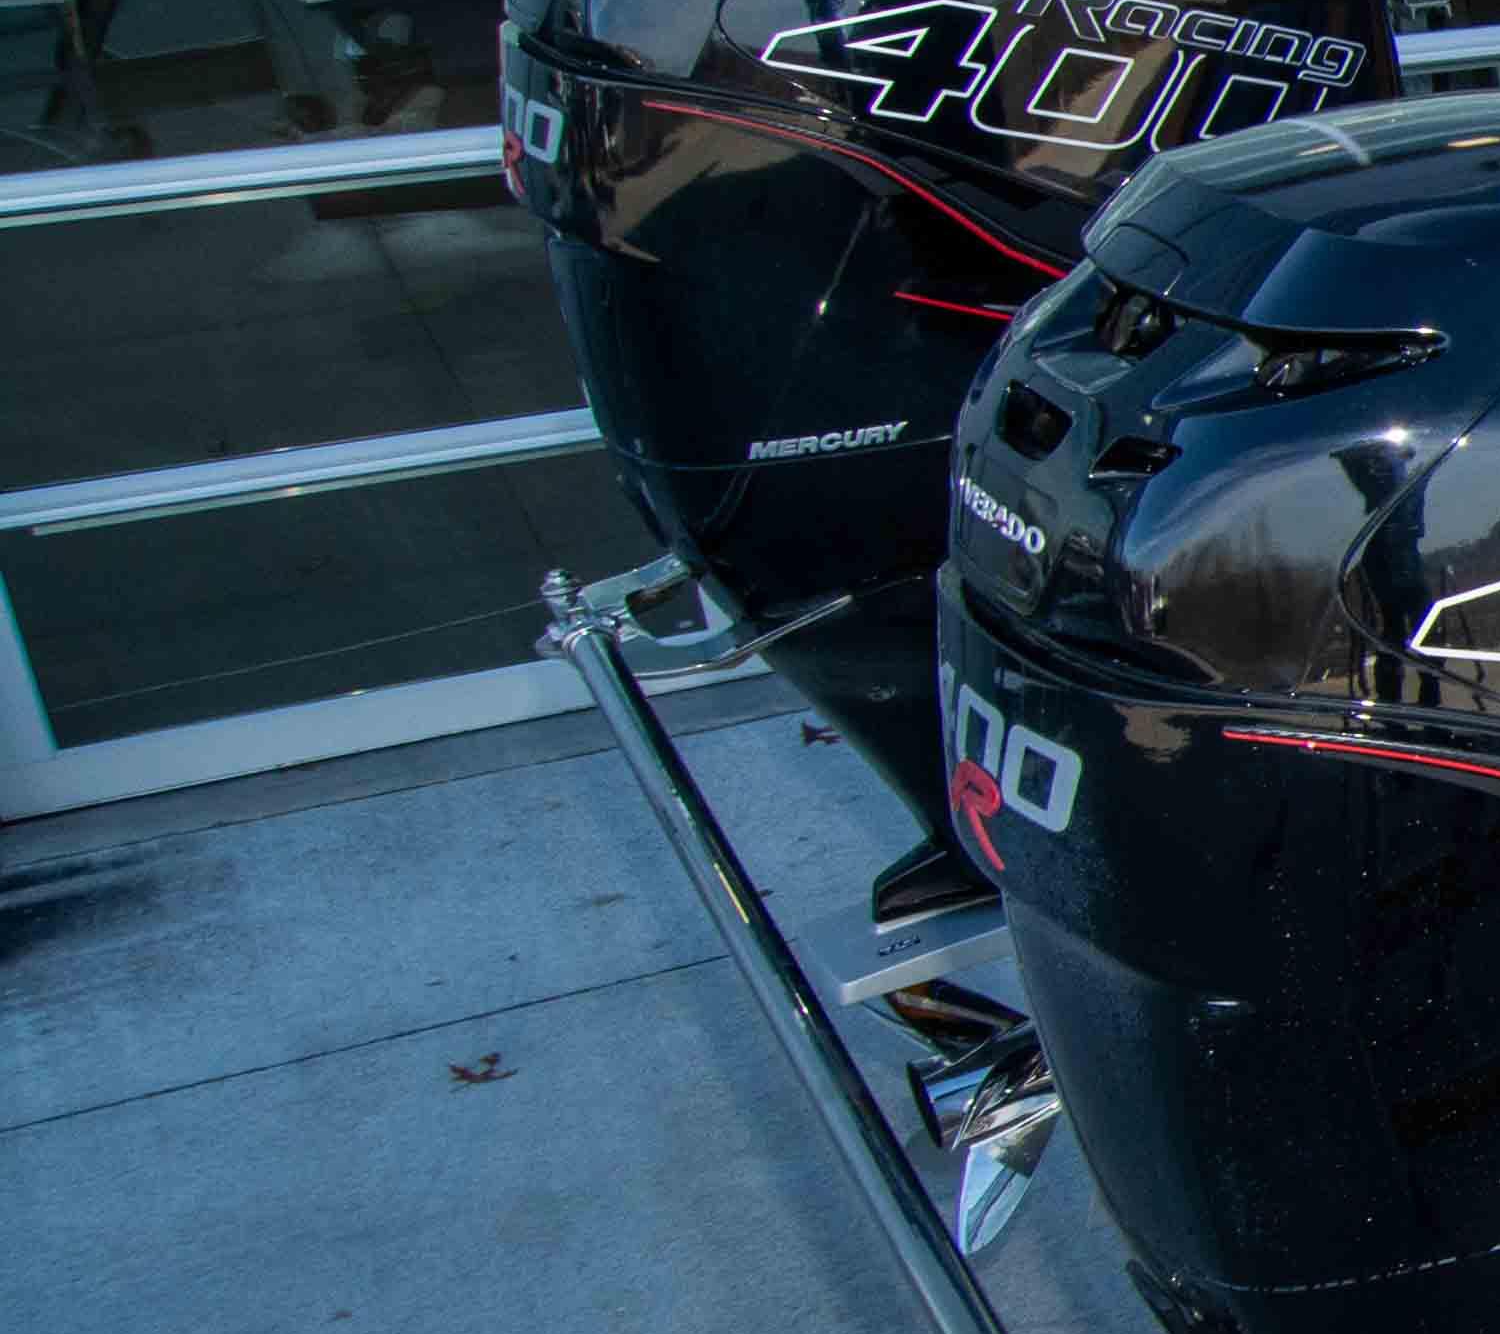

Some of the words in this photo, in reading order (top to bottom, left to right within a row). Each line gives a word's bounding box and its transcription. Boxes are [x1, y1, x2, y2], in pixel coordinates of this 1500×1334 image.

[749, 420, 909, 460] MERCURY
[959, 477, 1046, 554] VERADO
[940, 662, 1084, 834] 00
[952, 759, 1006, 872] R
